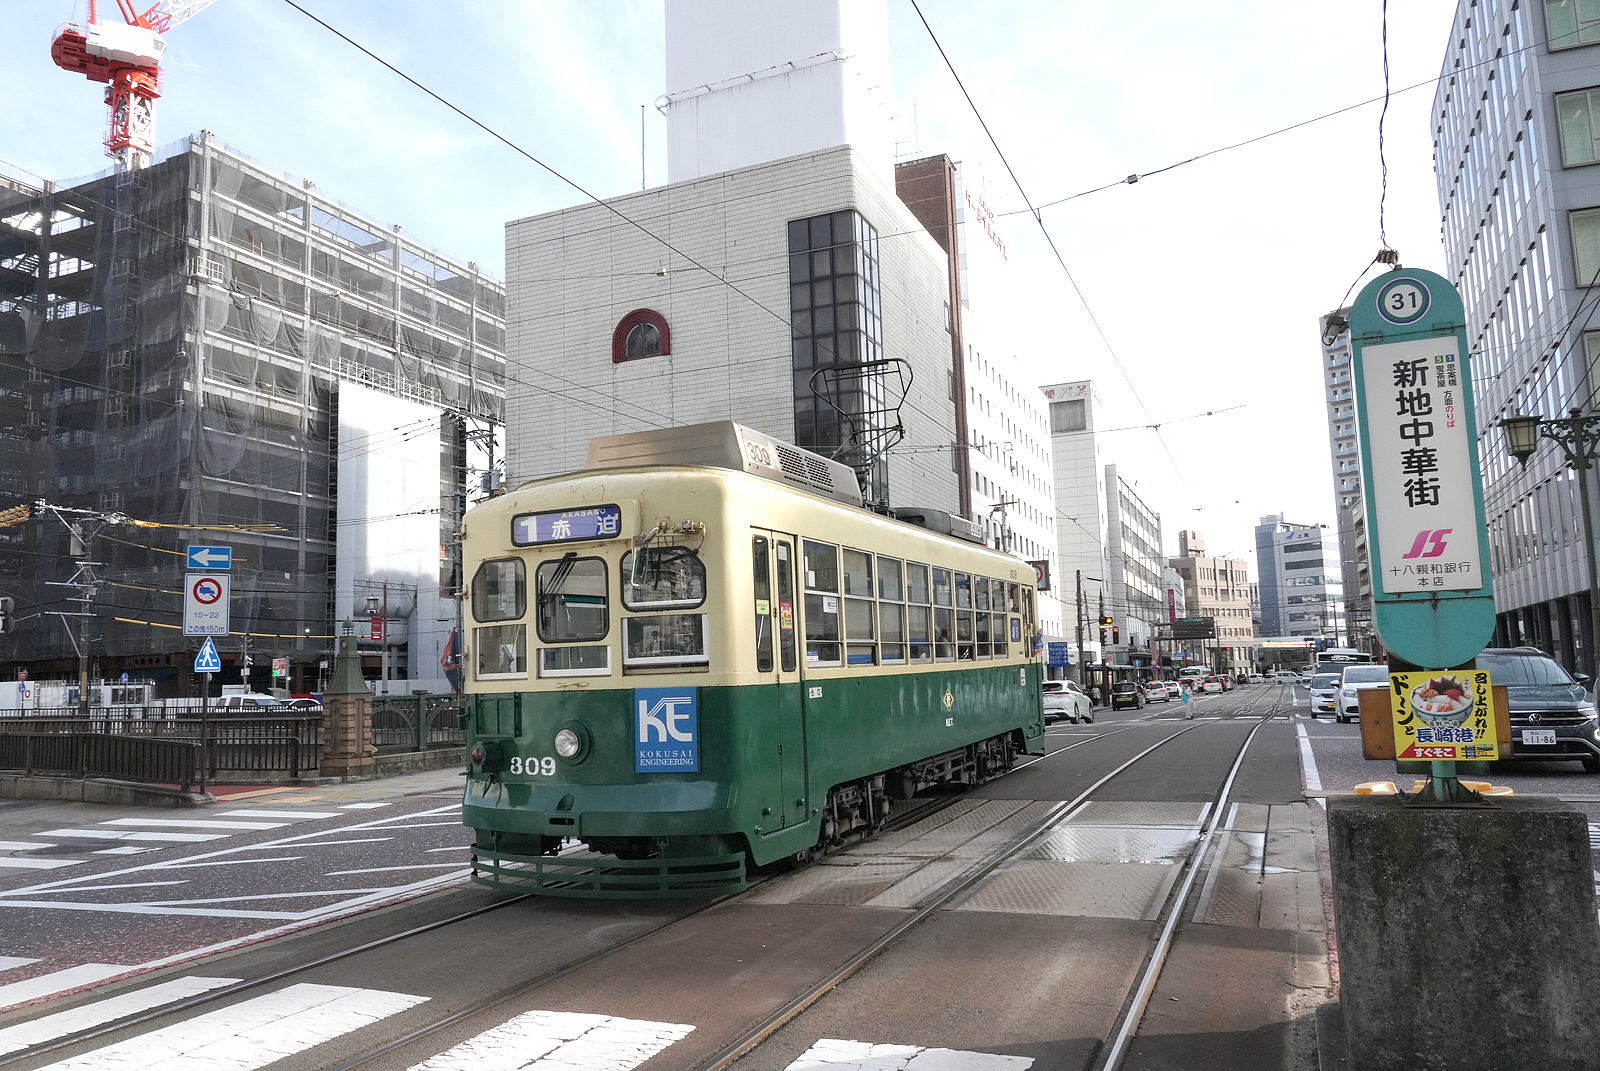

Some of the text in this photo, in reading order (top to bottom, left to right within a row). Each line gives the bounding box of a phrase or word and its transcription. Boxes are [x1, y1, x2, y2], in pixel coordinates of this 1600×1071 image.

[1391, 291, 1417, 310] 31
[1392, 357, 1441, 508] 新地中華街
[520, 516, 538, 542] 1
[1389, 562, 1471, 576] 十八親和銀行
[1417, 576, 1444, 587] 本店
[1416, 728, 1474, 743] 長崎港
[1414, 748, 1453, 758] すぐそこ
[510, 756, 556, 776] 309
